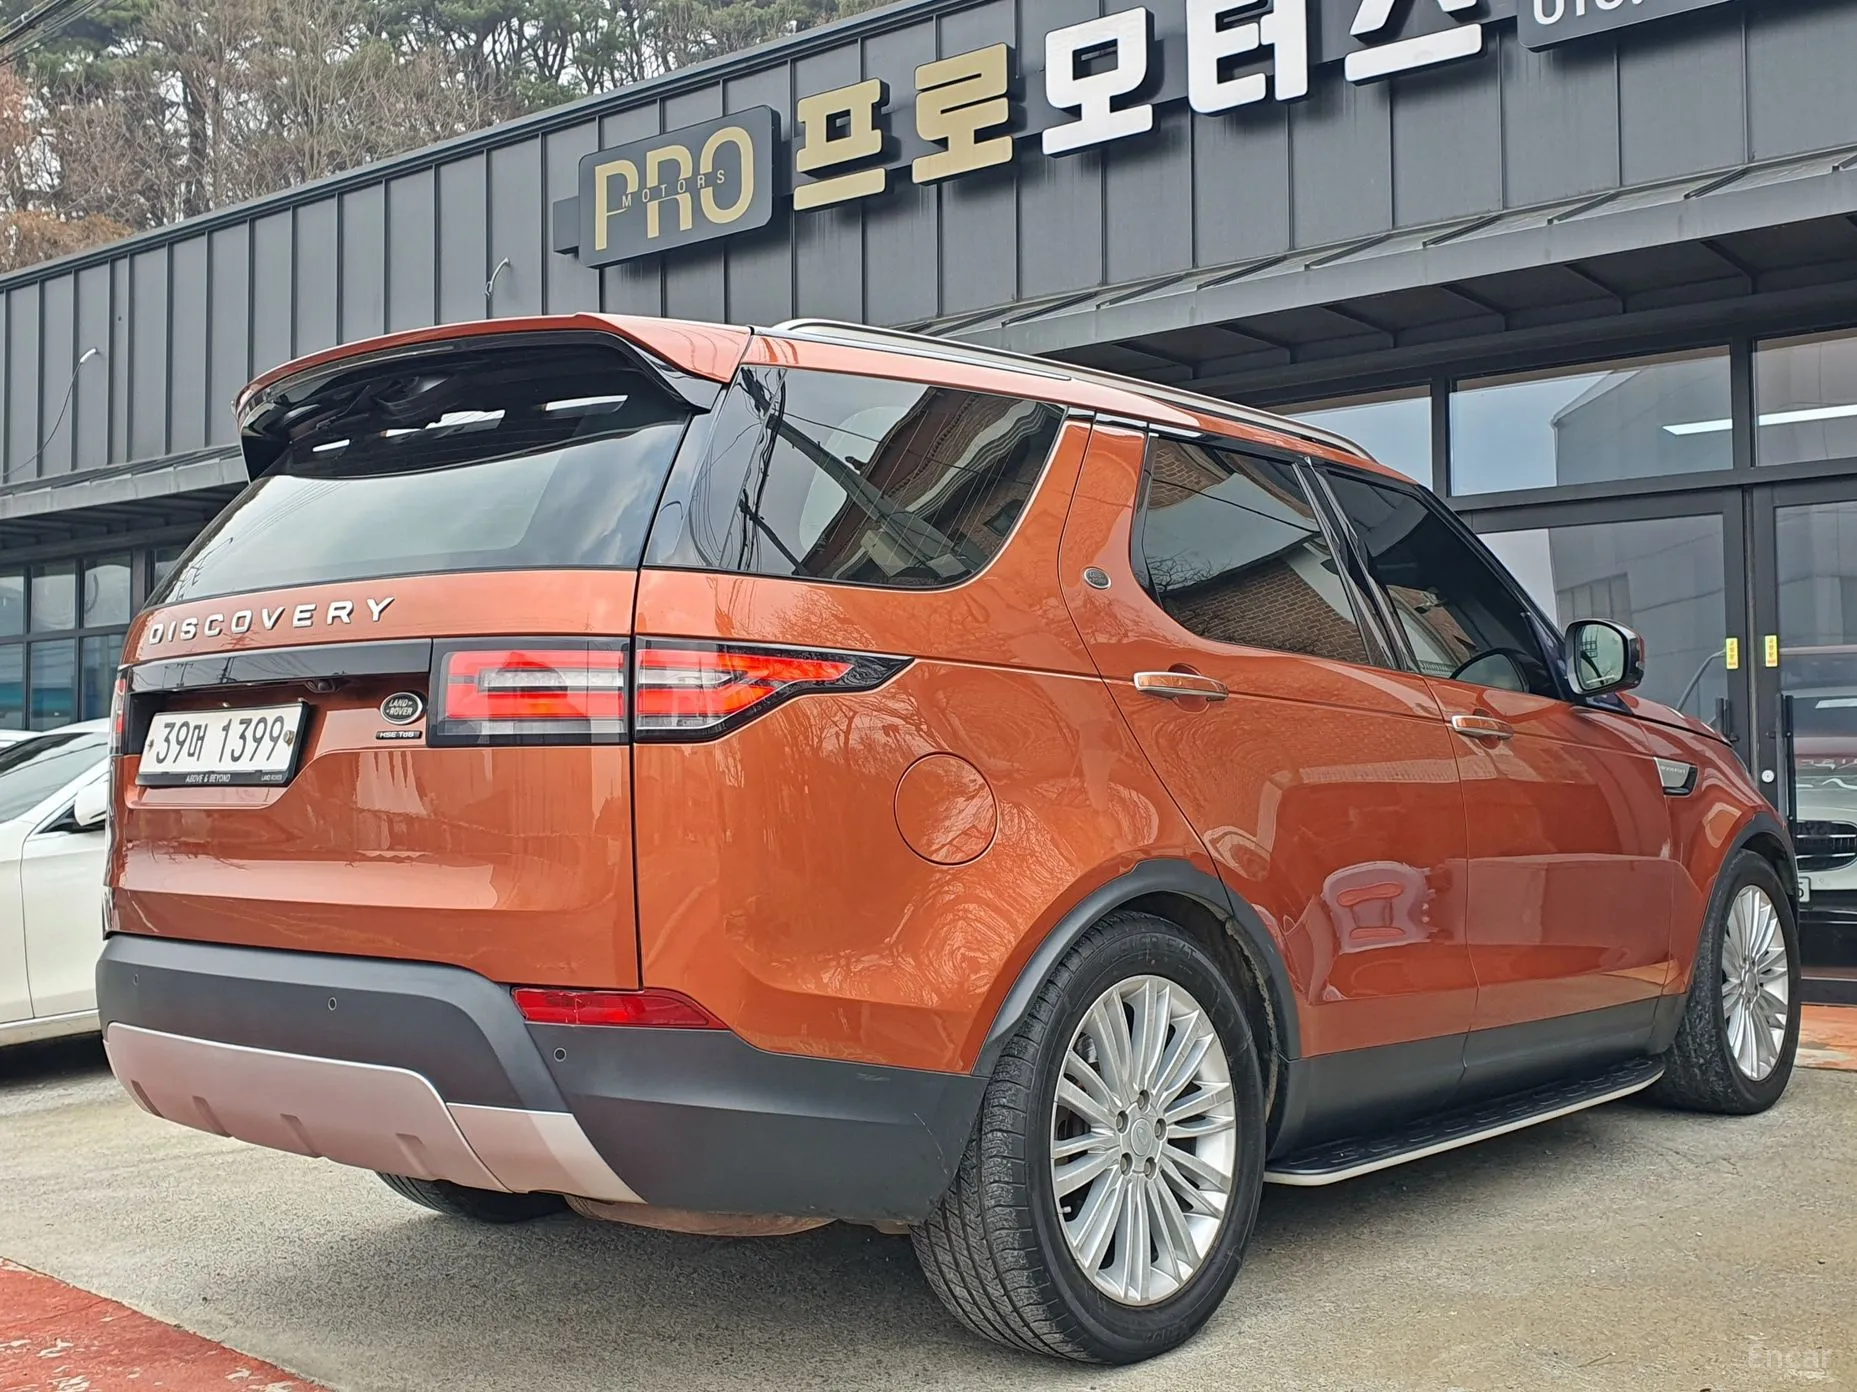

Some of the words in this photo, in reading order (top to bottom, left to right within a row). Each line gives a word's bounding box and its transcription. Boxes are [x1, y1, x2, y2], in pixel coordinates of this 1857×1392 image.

[792, 0, 1482, 211] 프로모터스
[595, 126, 755, 251] PRO
[622, 169, 725, 209] MOTORS
[148, 597, 395, 645] DISCOVERY
[389, 698, 409, 707] LAND
[389, 707, 413, 716] ROVER
[155, 721, 208, 764] 39머
[219, 715, 285, 763] 1399
[185, 774, 204, 784] ABOVE
[209, 773, 231, 783] BEYOND
